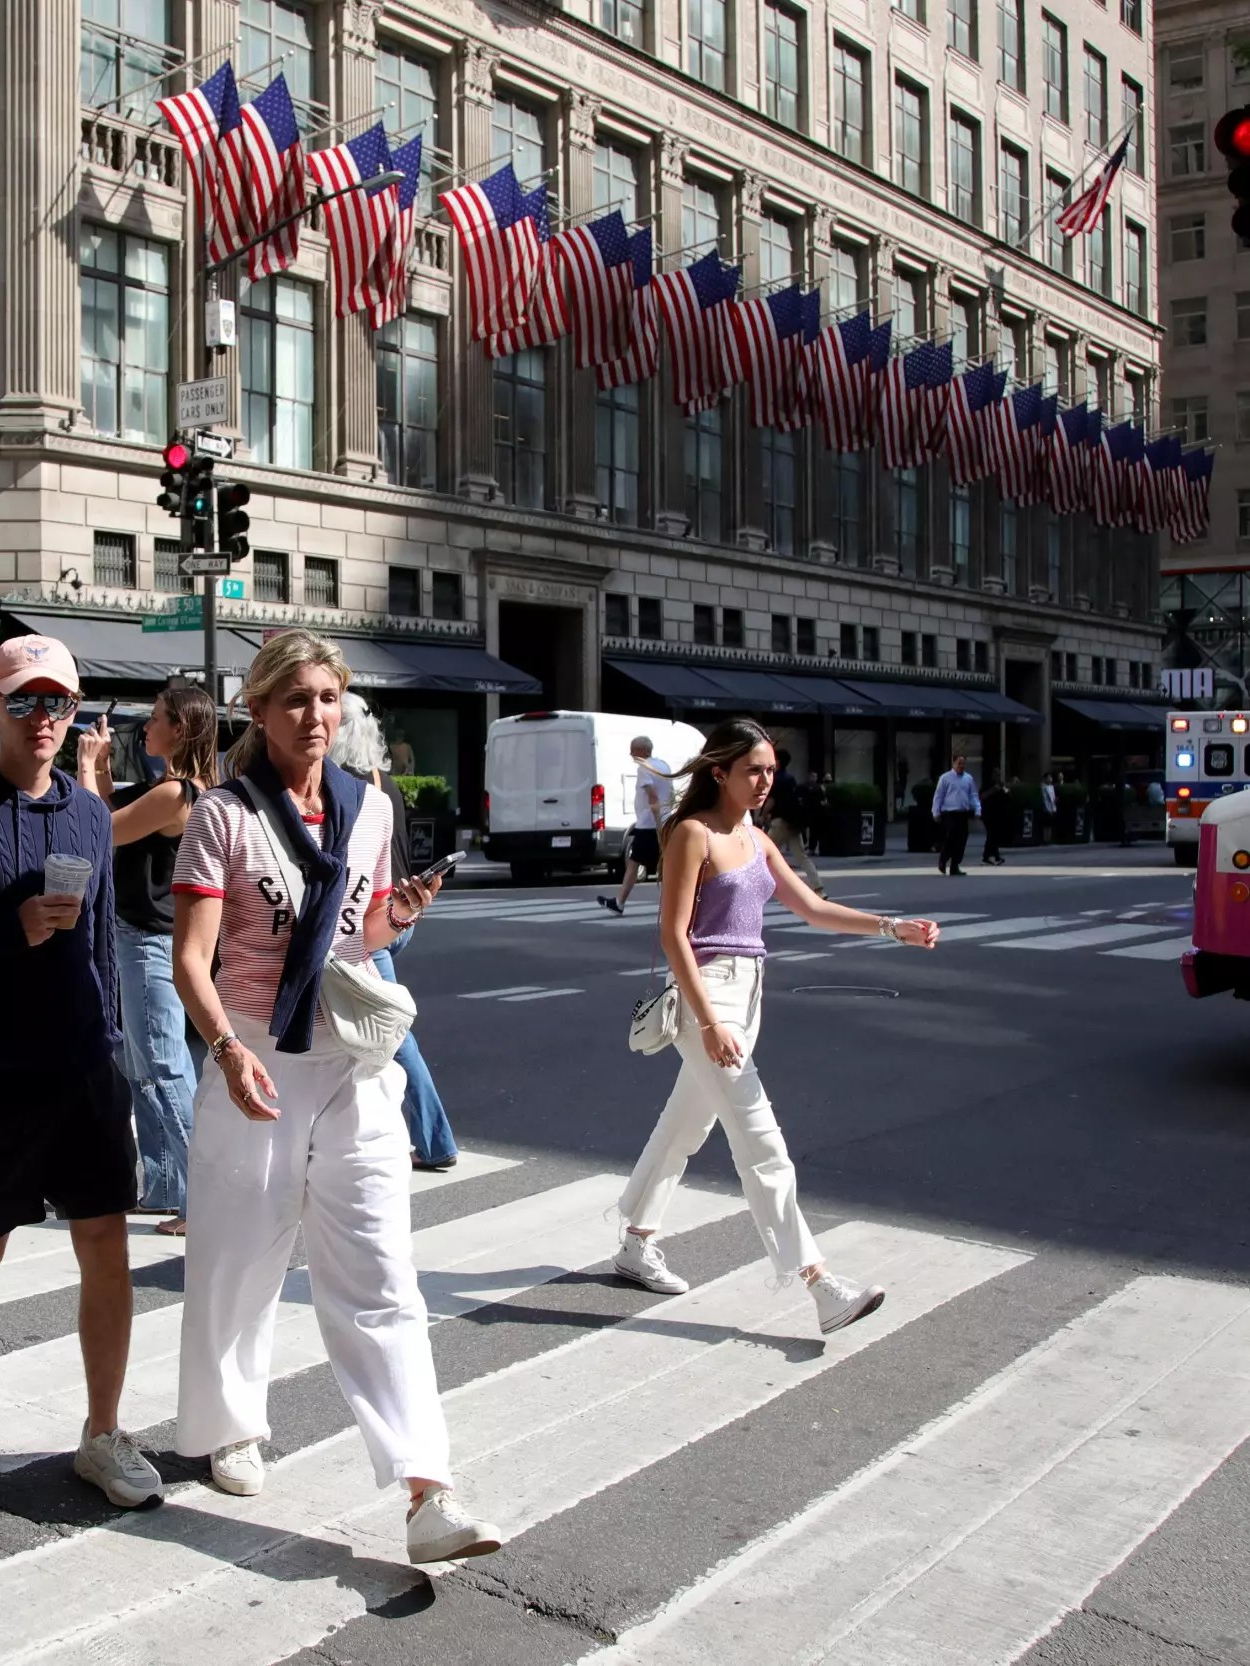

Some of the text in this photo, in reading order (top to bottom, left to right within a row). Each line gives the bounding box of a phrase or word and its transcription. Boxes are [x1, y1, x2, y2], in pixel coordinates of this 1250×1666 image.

[181, 384, 224, 402] PASSENGER
[181, 400, 225, 420] CARS ONLY
[185, 559, 224, 570] ONE WAY
[226, 581, 231, 595] 5
[183, 598, 194, 612] 50
